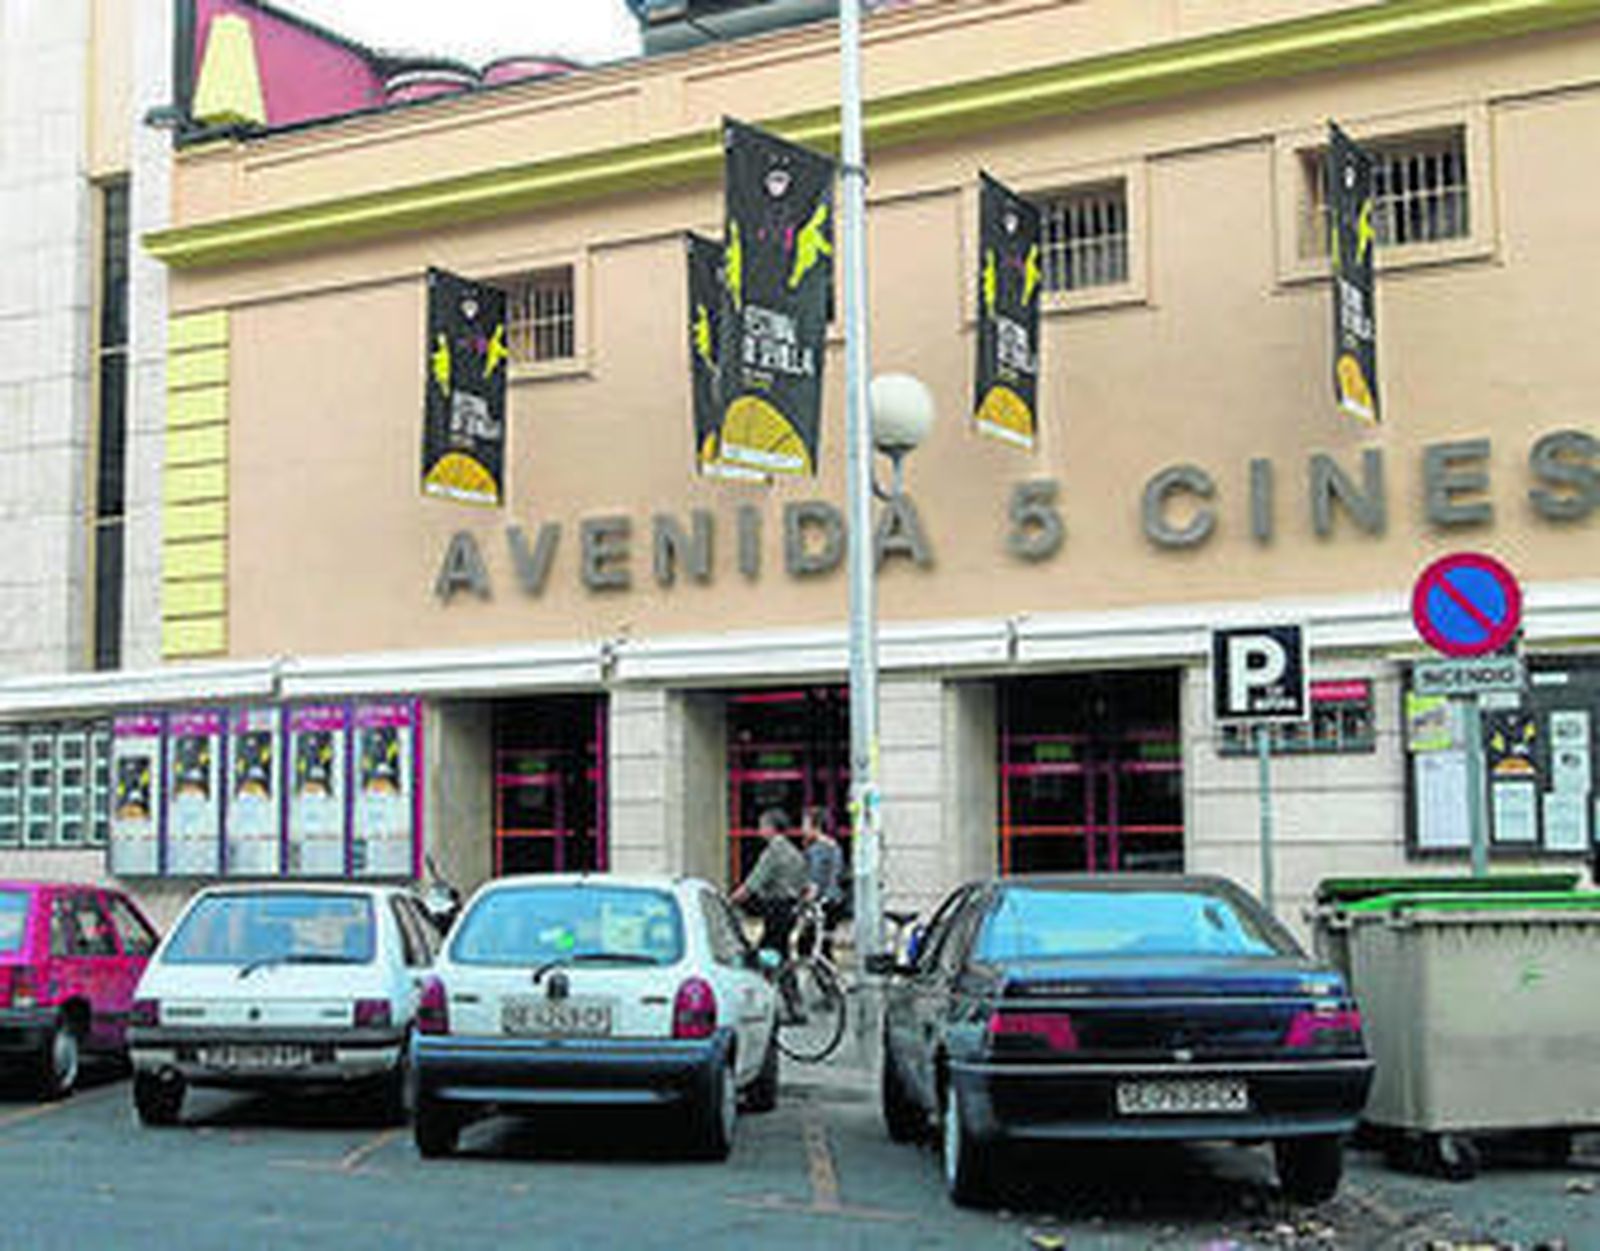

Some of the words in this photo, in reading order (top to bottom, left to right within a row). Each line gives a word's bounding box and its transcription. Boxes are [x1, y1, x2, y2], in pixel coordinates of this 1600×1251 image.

[434, 493, 935, 602] AVENIDA
[1005, 480, 1068, 563] 5
[1140, 429, 1600, 550] CINES
[1228, 634, 1288, 713] P
